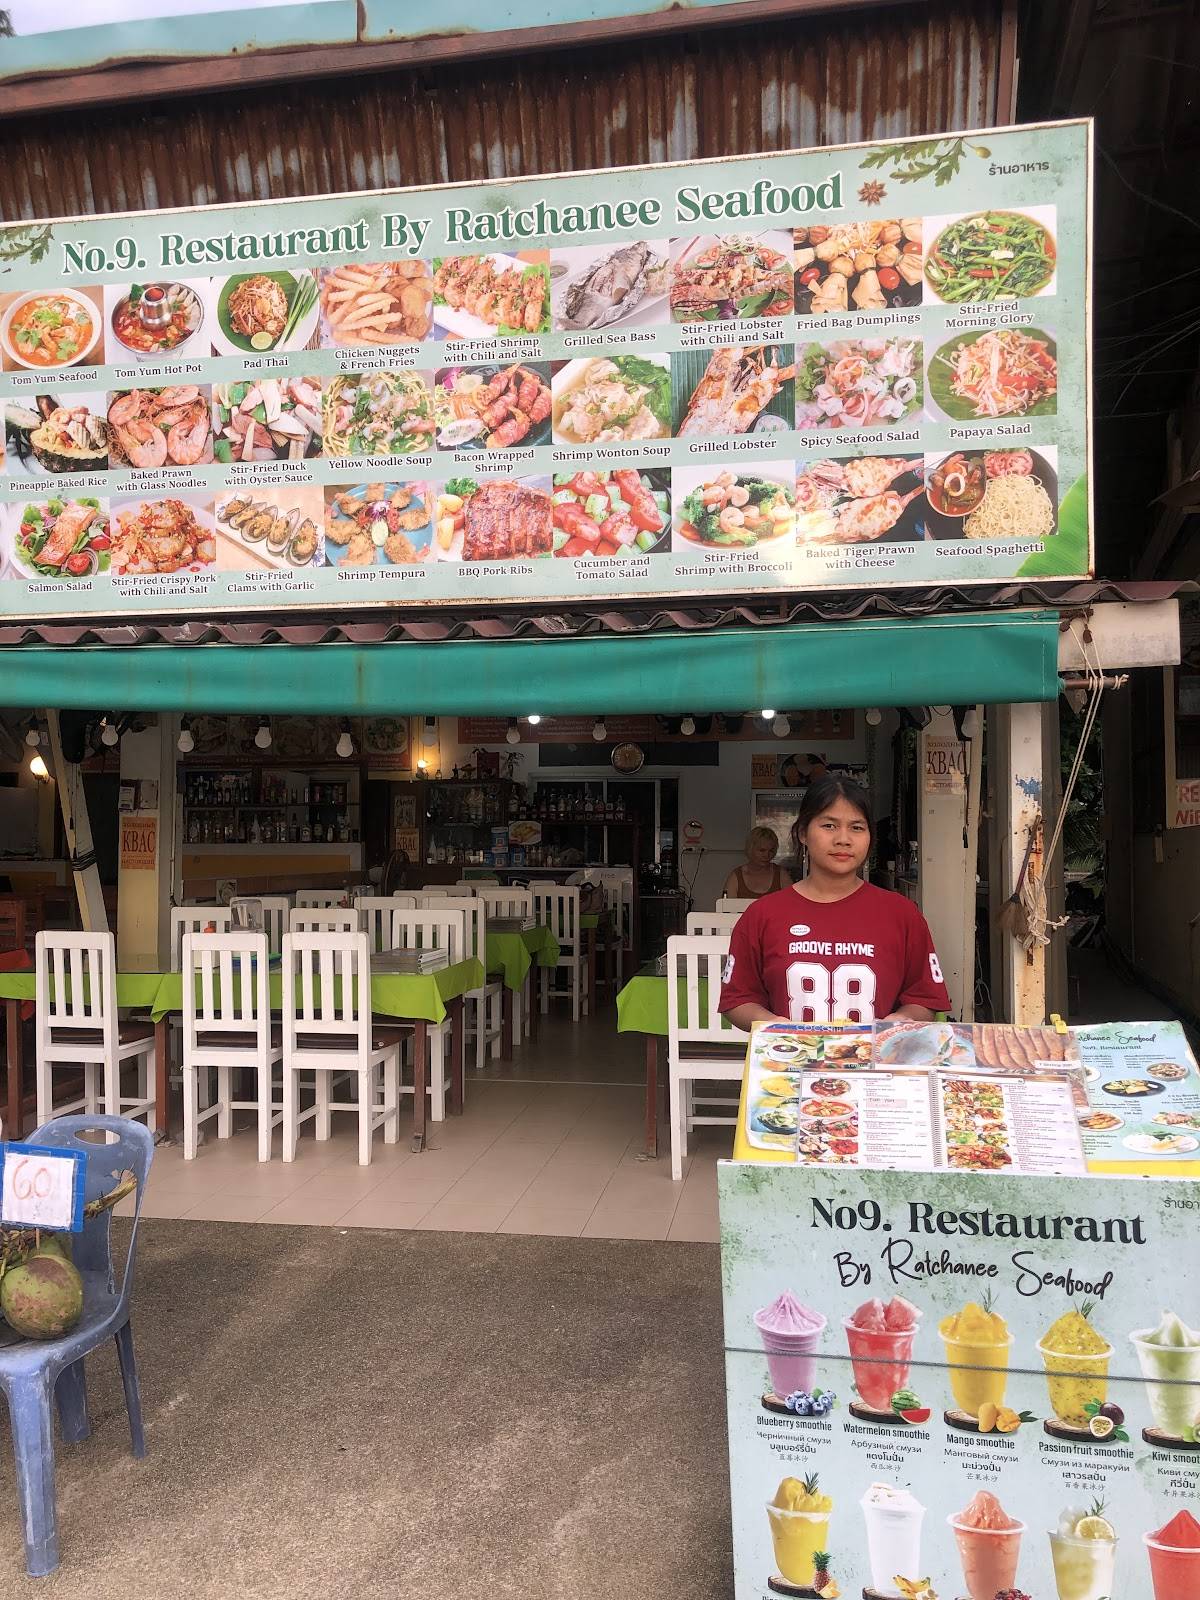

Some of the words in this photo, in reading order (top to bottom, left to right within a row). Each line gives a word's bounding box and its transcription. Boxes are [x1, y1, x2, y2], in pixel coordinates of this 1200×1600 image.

[989, 162, 1049, 176] ร้านอาหาร
[62, 238, 145, 273] No.9.
[161, 219, 368, 266] Restaurant
[382, 214, 431, 253] By
[446, 194, 660, 243] Ratchanee
[676, 172, 843, 223] Seafood
[959, 302, 1018, 314] Stir-Fried
[682, 322, 737, 334] Stir-Fried
[740, 319, 782, 330] Lobster
[797, 319, 828, 330] Fried
[832, 317, 853, 329] Bag
[856, 313, 920, 327] Dumplings
[946, 317, 997, 329] Morning
[1000, 314, 1033, 325] Glory
[446, 340, 497, 351] Stir-Fried
[500, 337, 539, 349] Shrimp
[564, 335, 604, 347] Grilled
[607, 334, 626, 343] Sea
[629, 332, 656, 342] Bass
[681, 336, 705, 346] with
[708, 334, 734, 345] Chili
[738, 332, 758, 342] and
[762, 331, 784, 340] Salt
[335, 349, 375, 359] Chicken
[378, 346, 420, 358] Nuggets
[444, 353, 467, 363] with
[470, 351, 496, 361] Chili
[498, 350, 518, 359] and
[521, 348, 542, 358] Salt
[243, 358, 263, 368] Pad
[266, 357, 288, 367] Thai
[350, 359, 381, 369] French
[383, 357, 415, 366] Fries
[12, 377, 32, 385] Tom
[35, 375, 56, 384] Yum
[59, 371, 97, 383] Seafood
[115, 369, 135, 378] Tom
[138, 368, 161, 377] Yum
[165, 365, 183, 374] Hot
[185, 364, 201, 373] Pot
[950, 427, 993, 439] Papaya
[996, 424, 1031, 435] Salad
[689, 442, 729, 453] Grilled
[733, 439, 776, 450] Lobster
[801, 436, 832, 448] Spicy
[835, 433, 883, 444] Seafood
[886, 431, 919, 441] Salad
[454, 452, 484, 462] Bacon
[488, 450, 534, 462] Wrapped
[552, 451, 593, 462] Shrimp
[596, 449, 640, 458] Wonton
[643, 446, 671, 457] Soup
[230, 464, 279, 474] Stir-Fried
[282, 463, 306, 472] Duck
[329, 459, 363, 469] Yellow
[366, 457, 402, 467] Noodle
[405, 456, 432, 467] Soup
[475, 462, 513, 473] Shrimp
[131, 470, 158, 480] Baked
[161, 469, 192, 478] Prawn
[225, 477, 246, 485] with
[249, 475, 281, 485] Oyster
[284, 474, 313, 482] Sauce
[10, 480, 55, 491] Pineapple
[57, 478, 85, 488] Baked
[88, 477, 107, 486] Rice
[117, 482, 137, 491] with
[140, 480, 166, 490] Glass
[168, 479, 207, 488] Noodles
[806, 549, 840, 559] Baked
[843, 547, 875, 558] Tiger
[877, 546, 915, 555] Prawn
[935, 545, 983, 556] Seafood
[986, 542, 1044, 554] Spaghetti
[574, 559, 627, 569] Cucumber
[630, 557, 650, 566] and
[705, 552, 759, 562] Stir-Fried
[825, 559, 851, 569] with
[854, 558, 895, 567] Cheese
[337, 571, 376, 582] Shrimp
[379, 569, 425, 580] Tempura
[459, 568, 479, 578] BBQ
[482, 566, 507, 576] Pork
[510, 565, 533, 574] Ribs
[576, 570, 615, 580] Tomato
[618, 568, 648, 578] Salad
[675, 566, 715, 577] Shrimp
[719, 564, 744, 573] with
[748, 561, 793, 572] Broccoli
[112, 577, 158, 587] Stir-Fried
[161, 576, 191, 586] Crispy
[194, 574, 216, 583] Pork
[245, 572, 293, 581] Stir-Fried
[28, 584, 63, 592] Salmon
[66, 581, 92, 591] Salad
[120, 588, 141, 597] with
[144, 587, 167, 596] Chili
[170, 586, 187, 594] and
[190, 585, 208, 594] Salt
[227, 583, 257, 593] Clams
[260, 582, 281, 591] with
[284, 581, 315, 591] Garlic
[122, 830, 155, 852] КВАС
[789, 941, 832, 955] GROOVE
[835, 943, 874, 957] RHYME
[928, 953, 944, 984] 8
[786, 961, 876, 1022] 88
[13, 1157, 51, 1200] 60
[811, 1197, 892, 1232] No9.
[909, 1202, 1146, 1245] Restaurant
[834, 1251, 871, 1287] By
[880, 1237, 999, 1284] Ratchanee
[1012, 1251, 1112, 1299] Seafood
[757, 1415, 795, 1430] Blueberry
[795, 1420, 832, 1431] smoothie
[843, 1423, 890, 1436] Watermelon
[893, 1428, 930, 1440] smoothie
[807, 1437, 832, 1445] смузи
[851, 1439, 893, 1451] Арбузный
[896, 1444, 922, 1453] смузи
[947, 1434, 975, 1449] Mango
[976, 1437, 1015, 1449] smoothie
[944, 1448, 990, 1460] Манговый
[992, 1454, 1019, 1463] смузи
[1039, 1441, 1072, 1453] Passion
[1074, 1445, 1092, 1455] fruit
[1094, 1447, 1134, 1459] smoothie
[1152, 1451, 1171, 1462] Kiwi
[1041, 1457, 1070, 1467] Смузи
[1157, 1467, 1181, 1477] Киви
